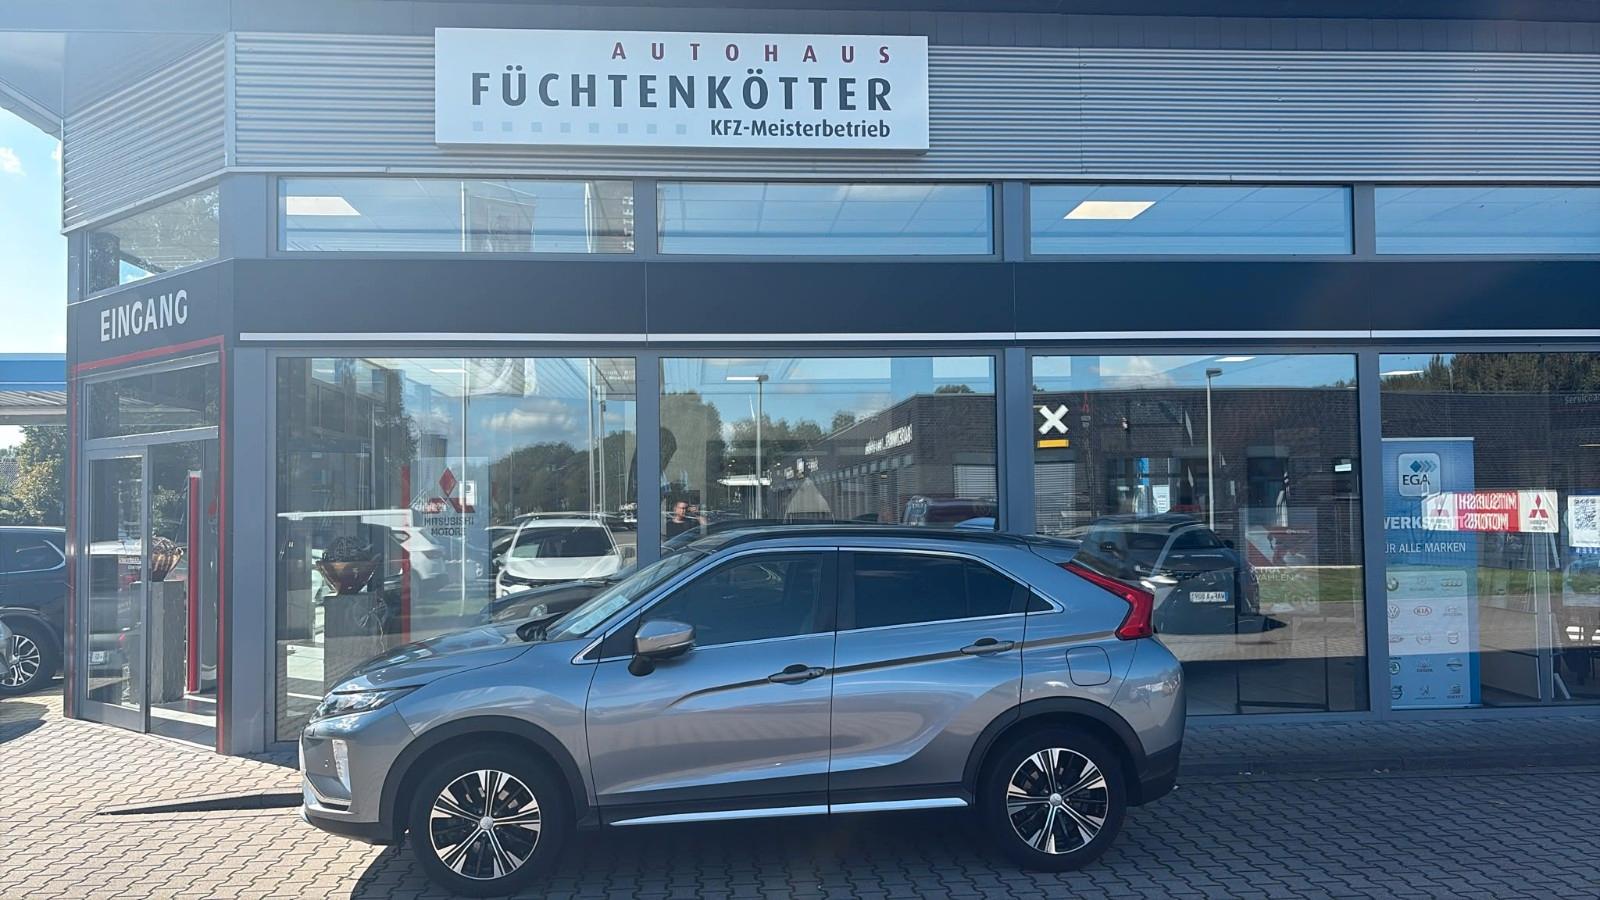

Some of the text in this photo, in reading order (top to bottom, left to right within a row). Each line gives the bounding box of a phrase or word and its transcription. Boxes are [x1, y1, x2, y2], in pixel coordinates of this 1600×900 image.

[611, 41, 890, 64] AUTOHAUS
[471, 64, 892, 112] FÜCHTENKÖTTER
[710, 119, 891, 139] KFZ-Meisterbetrieb
[100, 289, 188, 342] EINGANG
[1402, 474, 1431, 486] EGA
[424, 516, 474, 526] MITSUBISHI
[1398, 542, 1421, 553] ALLE
[1424, 542, 1466, 553] MARKEN
